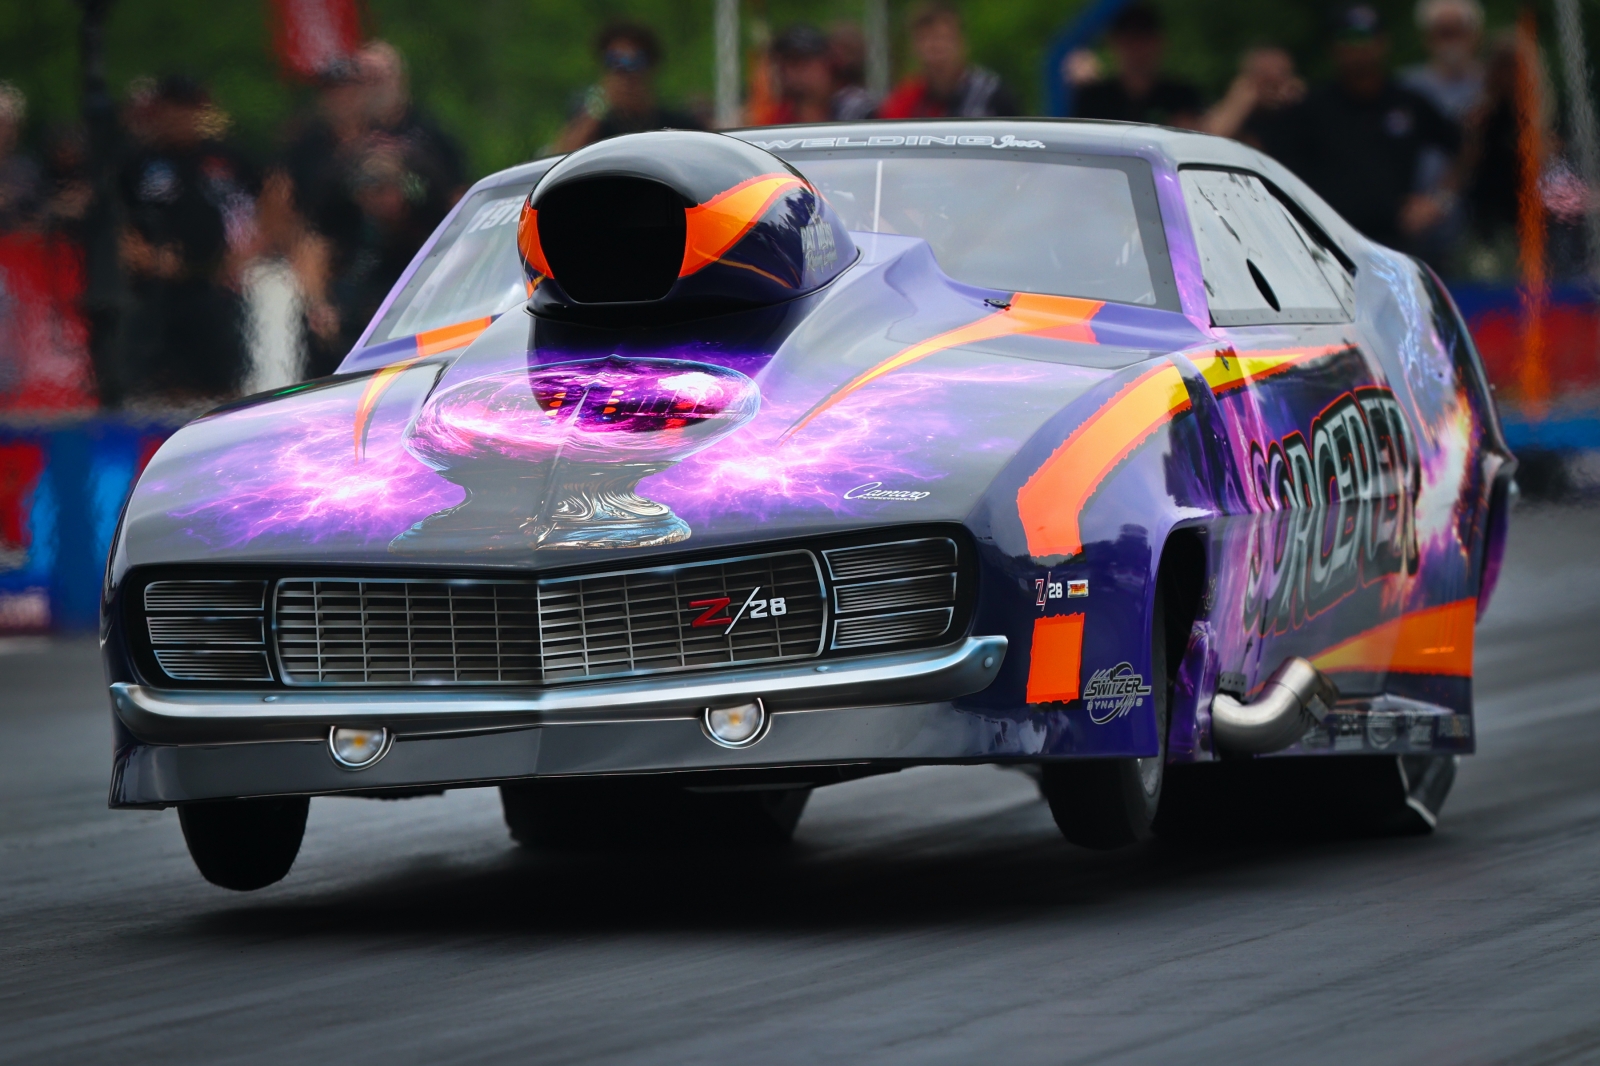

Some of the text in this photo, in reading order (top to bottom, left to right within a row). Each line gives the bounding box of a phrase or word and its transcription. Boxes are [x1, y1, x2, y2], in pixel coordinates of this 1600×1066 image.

[752, 134, 1046, 149] WELDING Inc.
[843, 482, 930, 500] Camaro
[1035, 571, 1063, 611] Z/28
[688, 586, 787, 634] Z/28
[1083, 675, 1152, 699] SWITZER
